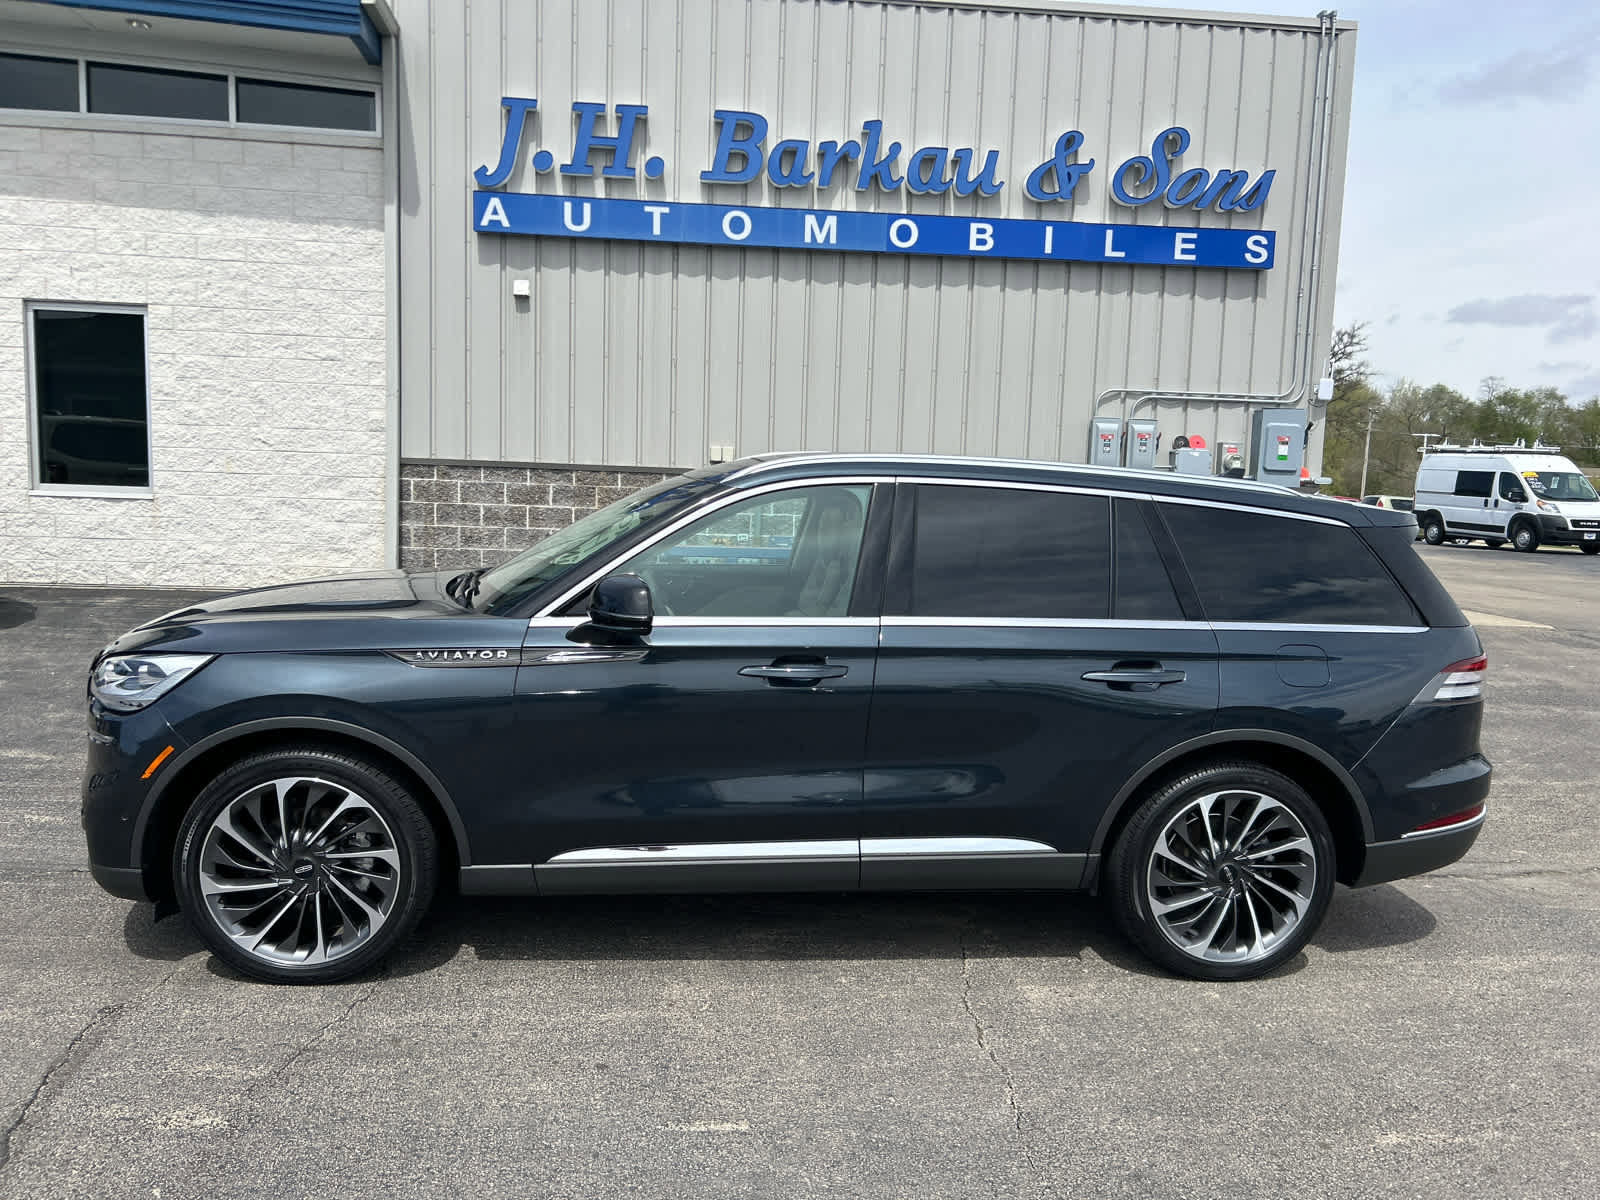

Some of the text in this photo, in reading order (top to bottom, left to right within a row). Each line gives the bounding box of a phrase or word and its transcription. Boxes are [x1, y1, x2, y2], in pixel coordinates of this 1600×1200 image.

[473, 97, 1277, 213] J.H. Barkau & Sons
[480, 197, 1269, 264] AUTOMOBILES
[415, 650, 508, 660] AVIATOR
